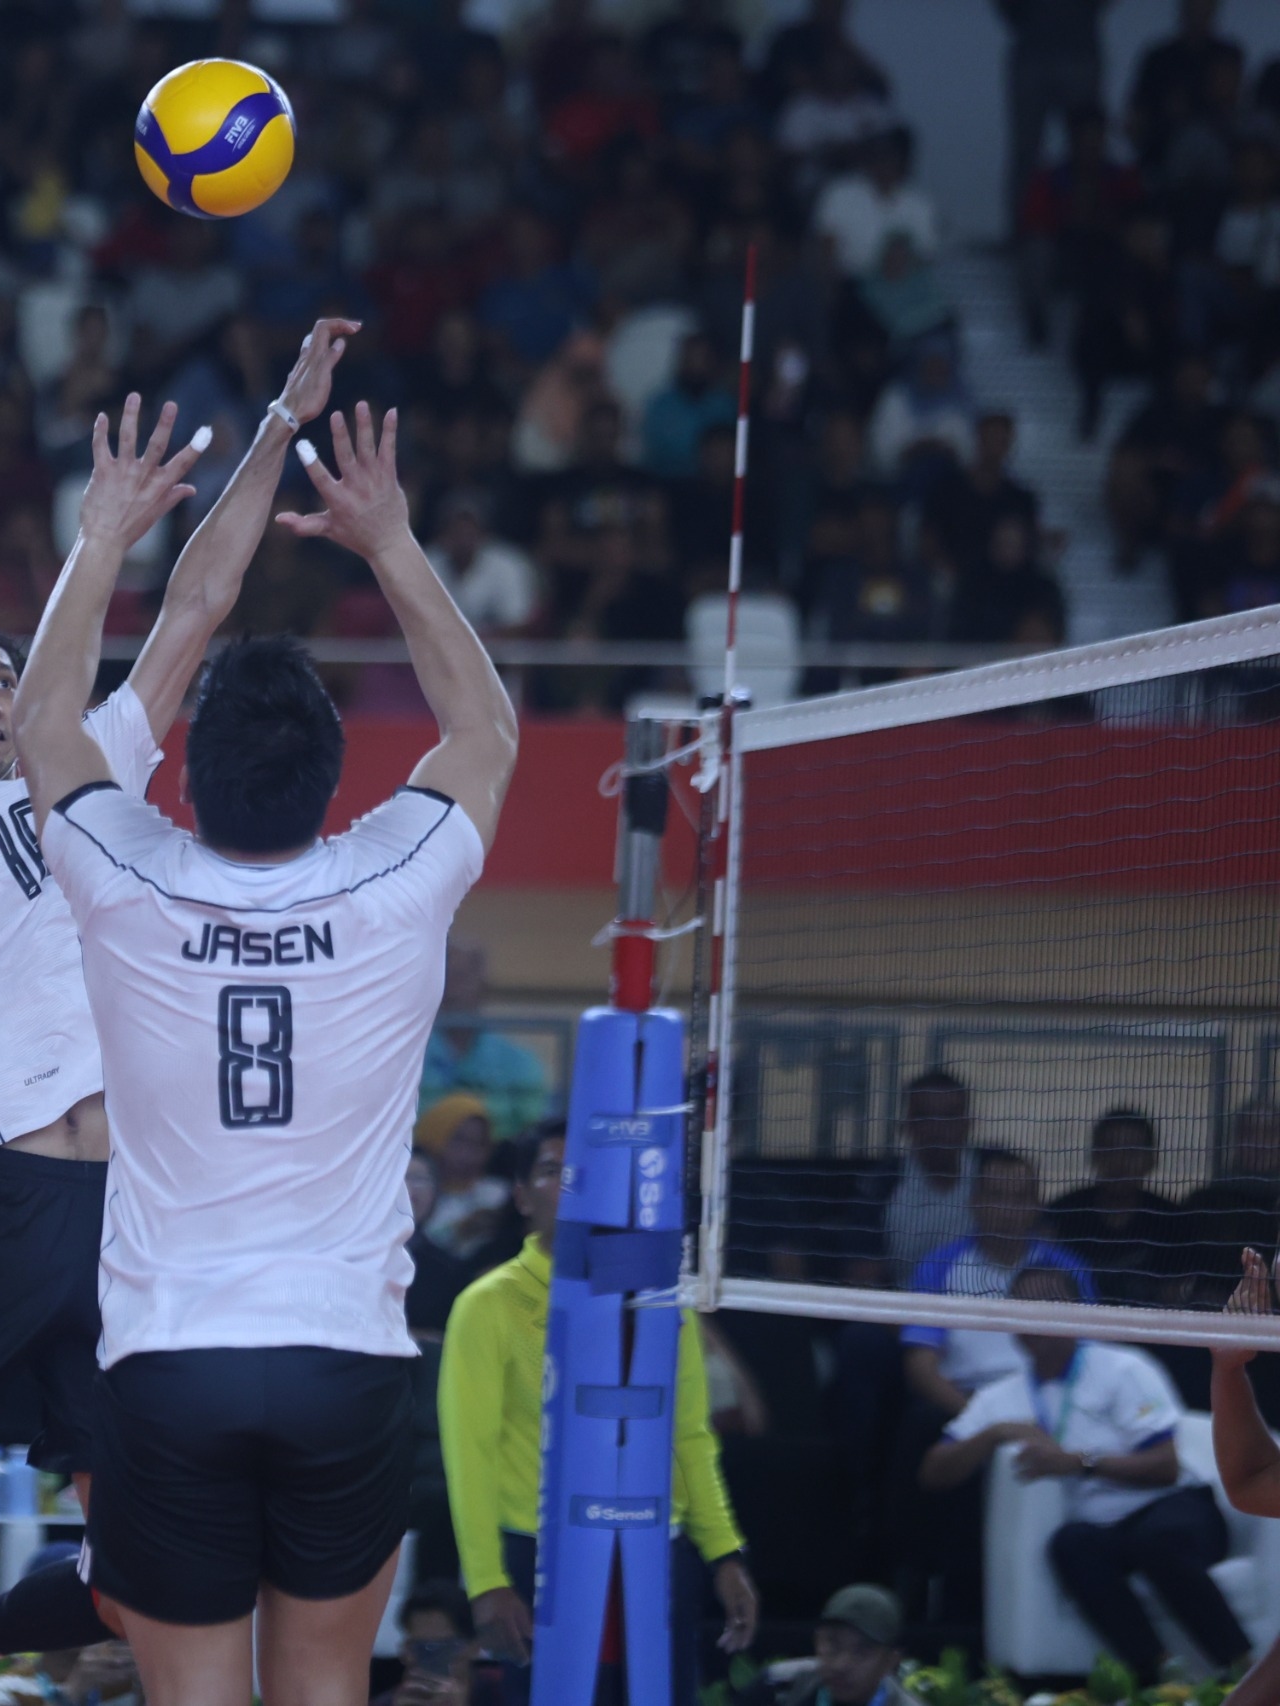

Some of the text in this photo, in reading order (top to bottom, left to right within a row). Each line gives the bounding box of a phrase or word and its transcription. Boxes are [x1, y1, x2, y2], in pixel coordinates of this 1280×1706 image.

[181, 920, 335, 967] JASEN
[24, 1066, 60, 1087] ULTRADRY
[218, 985, 294, 1130] 8
